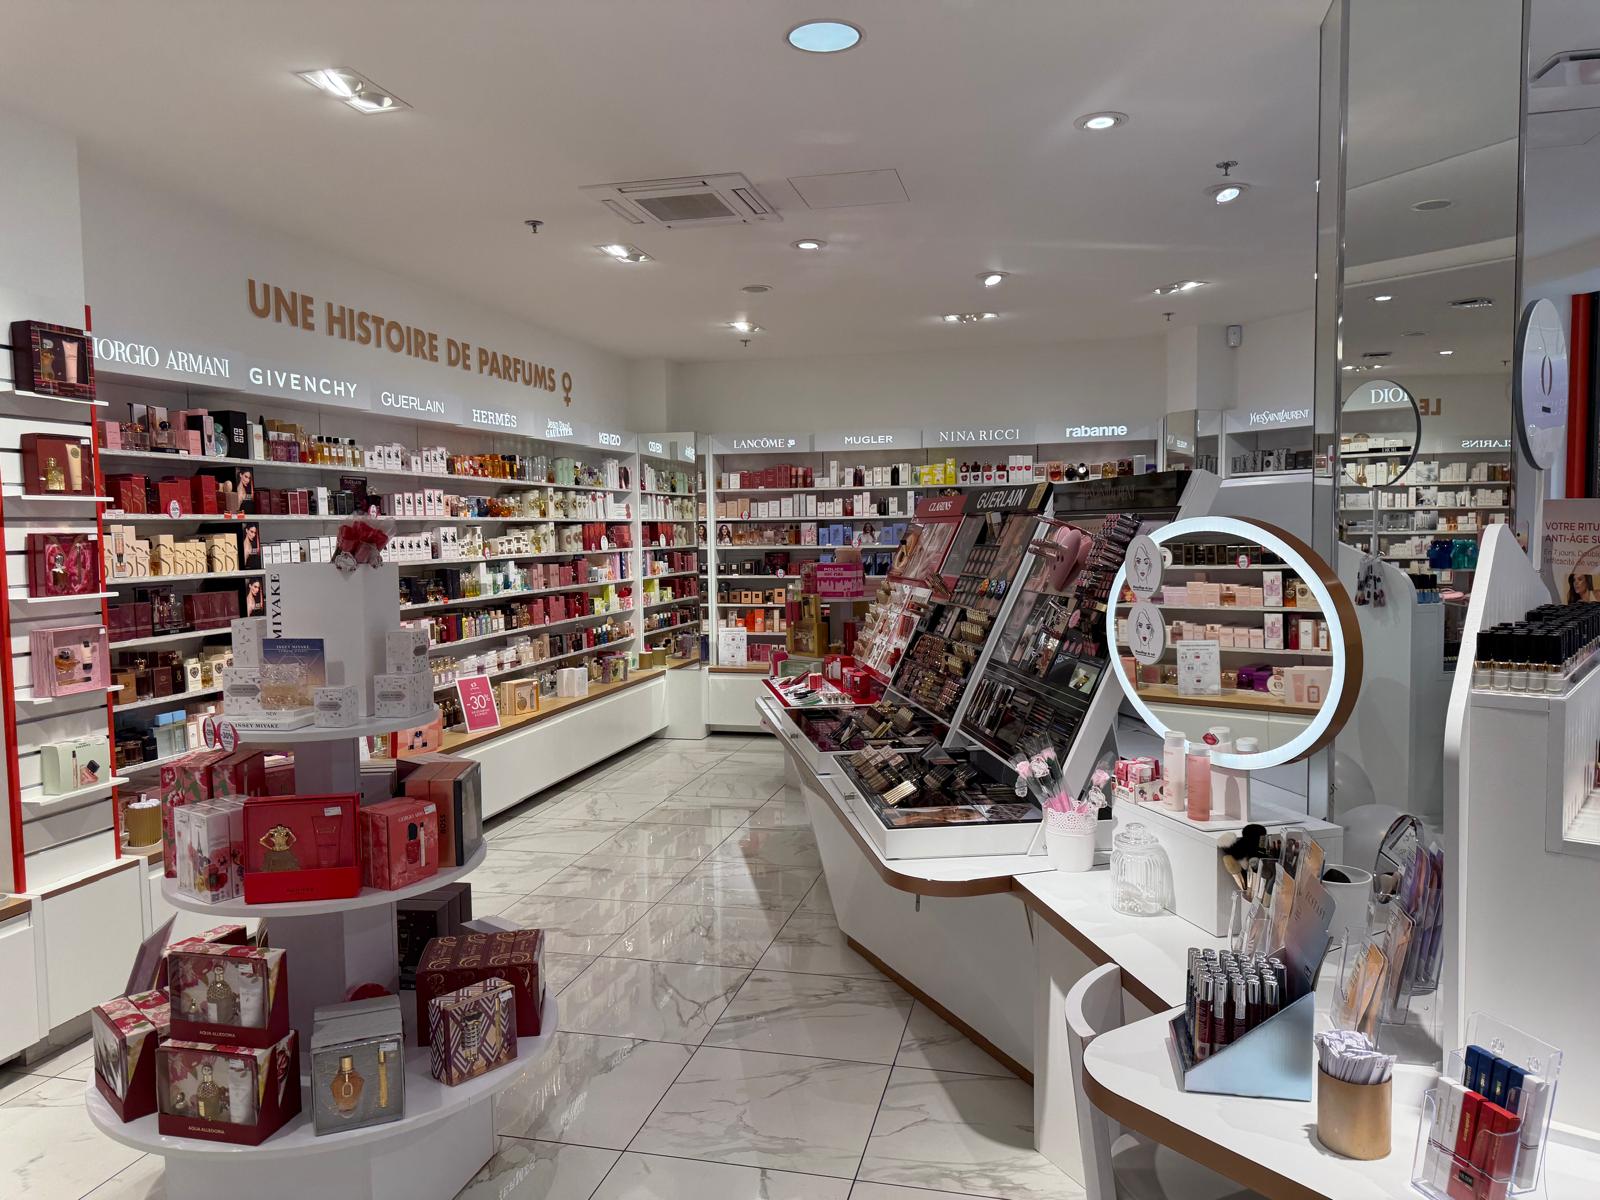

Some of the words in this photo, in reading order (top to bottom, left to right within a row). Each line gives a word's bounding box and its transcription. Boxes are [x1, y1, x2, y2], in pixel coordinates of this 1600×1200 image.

[247, 278, 315, 331] UNE
[325, 301, 439, 363] HISTOIRE
[446, 337, 471, 371] DE
[478, 346, 556, 393] PARFUMS
[92, 337, 160, 367] IORGIO
[165, 350, 230, 378] ARMANI
[249, 367, 357, 398] GIVENCHY
[381, 391, 445, 414] GUERLAIN
[939, 430, 976, 442] NINA
[979, 429, 1020, 441] RICCI
[1065, 425, 1128, 438] rabanne
[598, 432, 621, 446] KENZO
[844, 435, 894, 444] MUGLER
[976, 488, 1028, 509] GUERLAIN
[928, 501, 953, 512] CLARINS
[1545, 522, 1576, 531] VOTRE
[1545, 532, 1589, 544] ANTI-ÂGE
[467, 694, 491, 710] -30%
